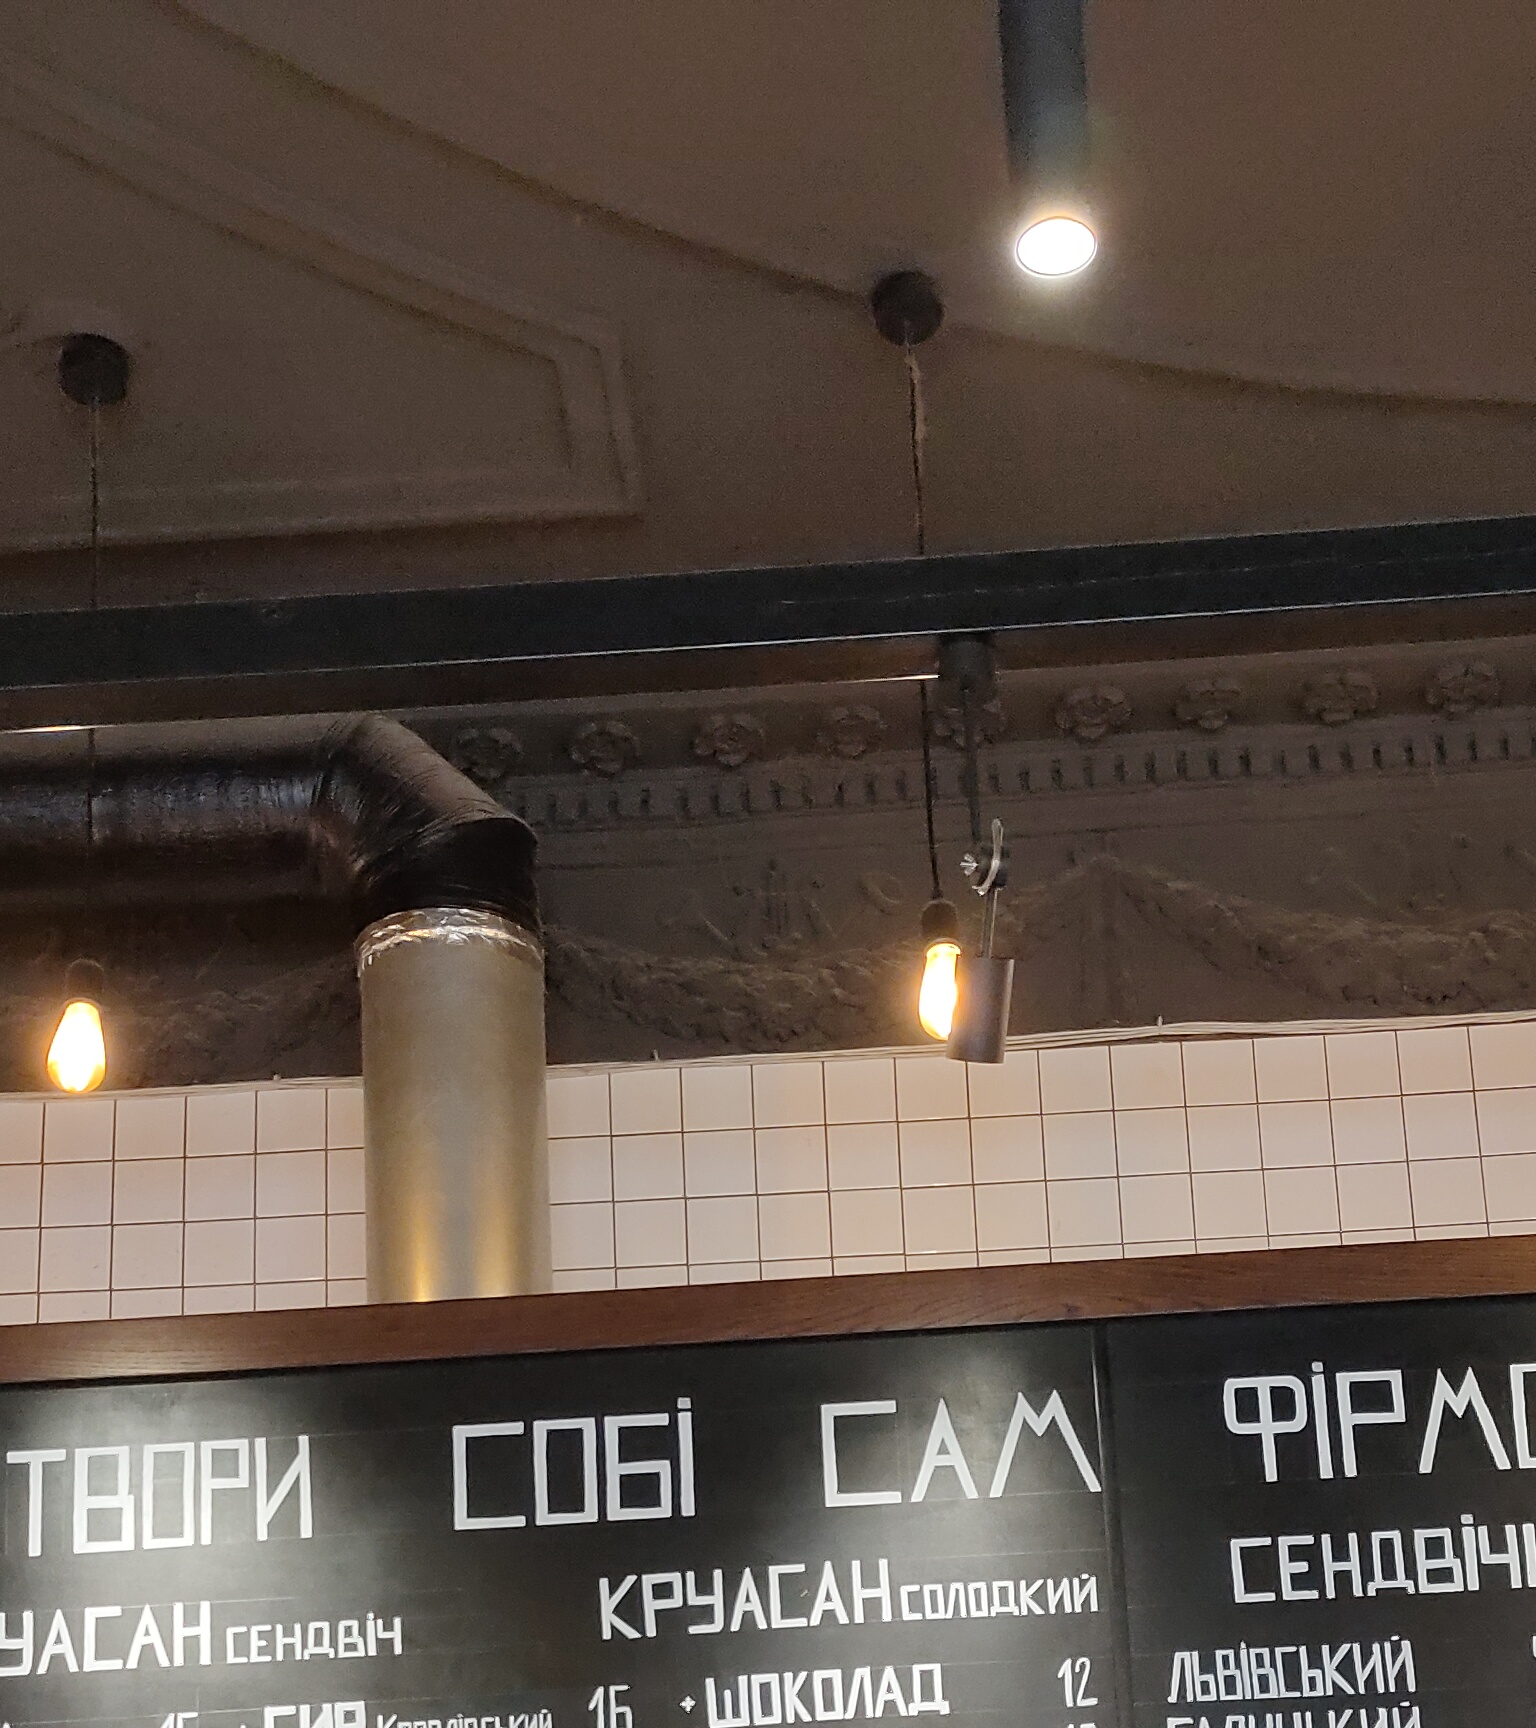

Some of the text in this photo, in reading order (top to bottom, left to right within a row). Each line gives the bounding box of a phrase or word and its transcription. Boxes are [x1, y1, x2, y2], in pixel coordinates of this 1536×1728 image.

[451, 1396, 696, 1531] СОБІ
[820, 1390, 1104, 1508] САМ
[598, 1558, 1099, 1641] КРУАСАН СОЛОДКИЙ
[226, 1610, 403, 1664] СЕНДВІЧ
[1167, 1634, 1417, 1704] ЛЬВІВСЬКИЙ
[1057, 1656, 1099, 1708] 12
